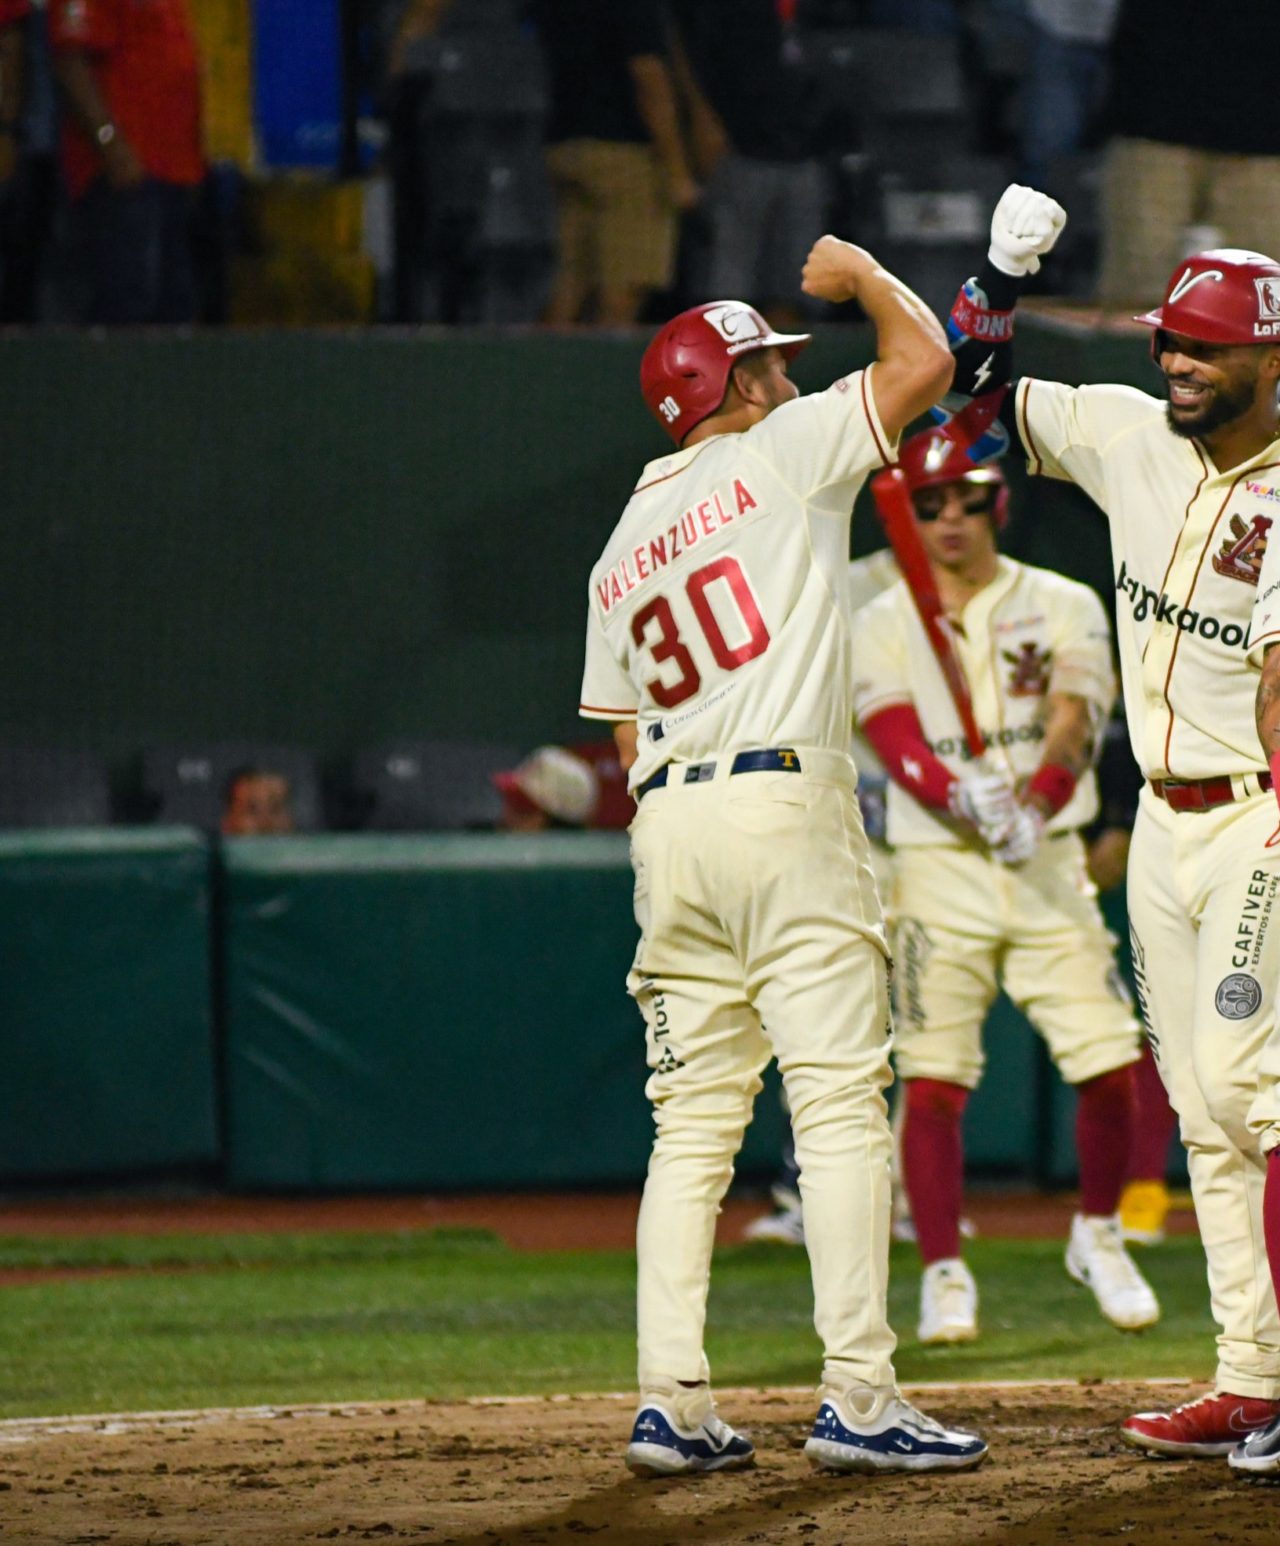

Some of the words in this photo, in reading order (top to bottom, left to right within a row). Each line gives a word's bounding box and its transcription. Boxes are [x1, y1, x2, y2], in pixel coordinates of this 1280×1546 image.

[659, 396, 681, 423] 30
[597, 479, 758, 612] VALENZUELA
[631, 555, 771, 709] 30
[778, 751, 798, 767] T
[1232, 869, 1270, 968] CAFIVER
[1252, 917, 1270, 965] EXPERTOS
[1264, 901, 1273, 914] EN
